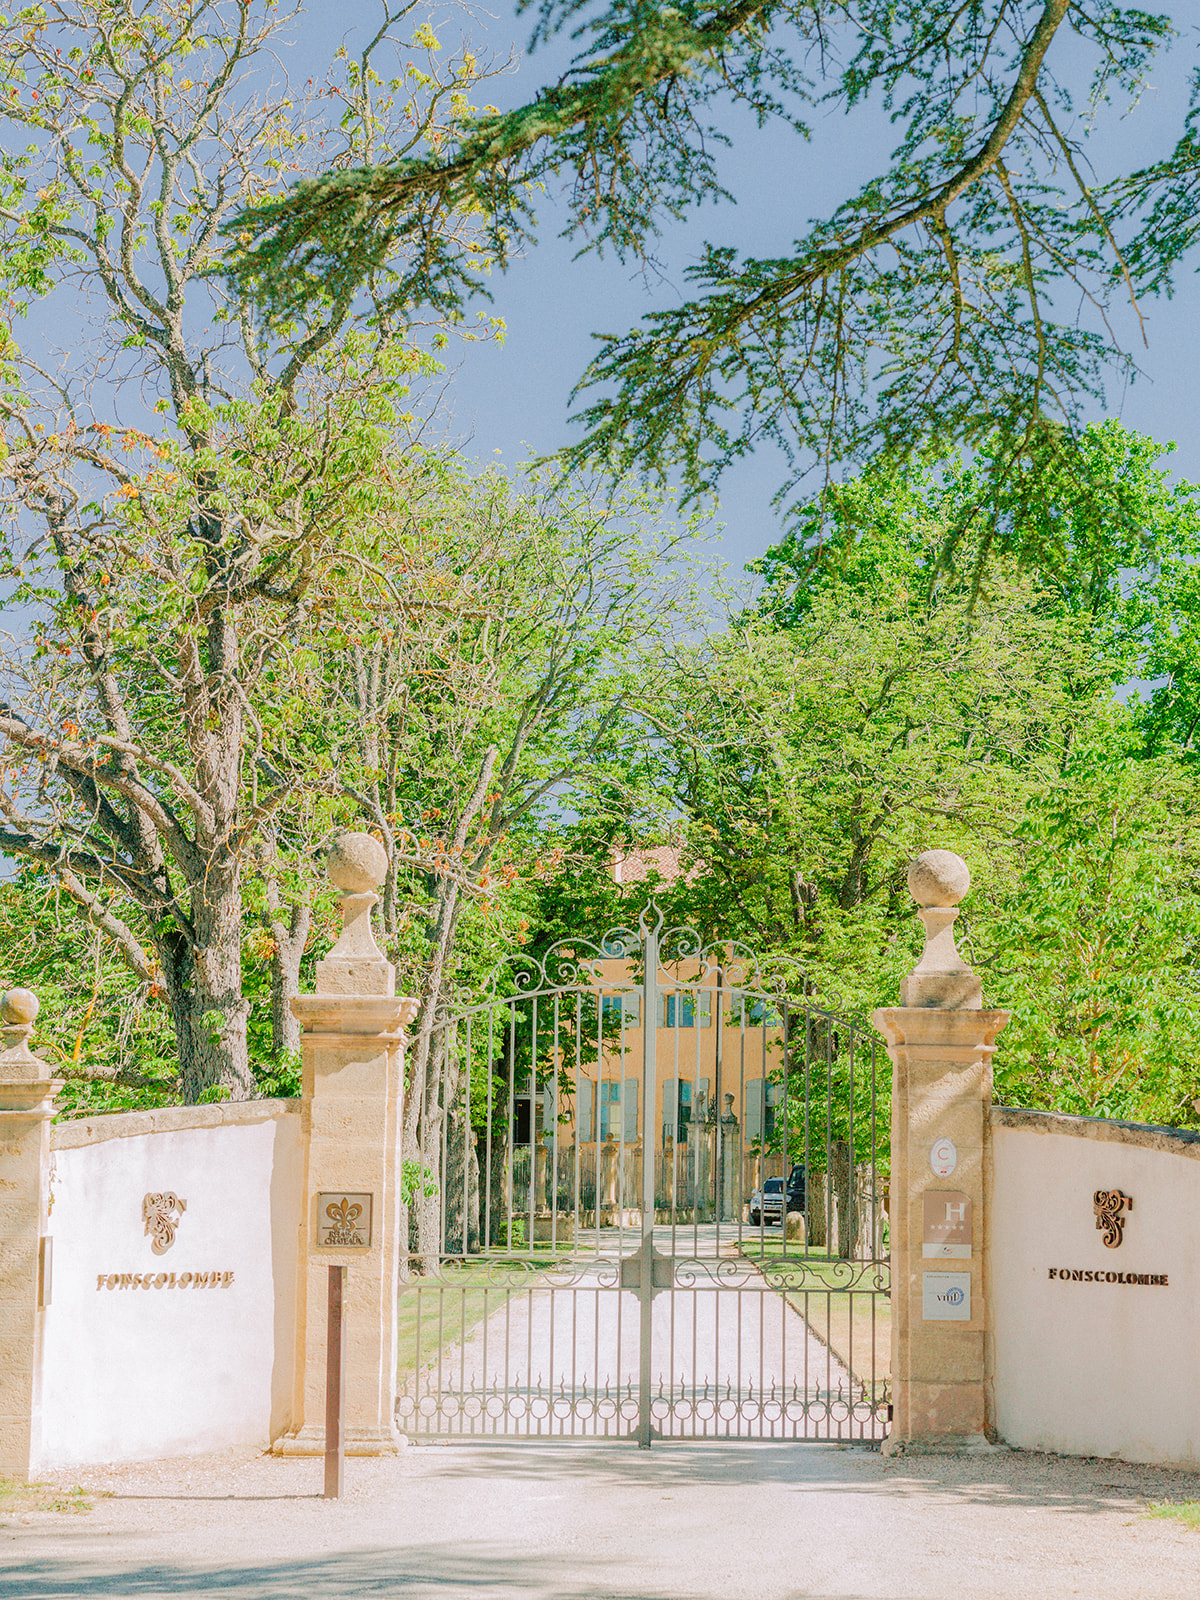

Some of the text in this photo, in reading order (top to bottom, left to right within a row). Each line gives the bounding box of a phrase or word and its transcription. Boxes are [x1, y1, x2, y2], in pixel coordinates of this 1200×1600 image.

[944, 1202, 965, 1222] H
[96, 1271, 235, 1291] FONSCOLOMBE
[1047, 1267, 1169, 1286] FONSCOLOMBE
